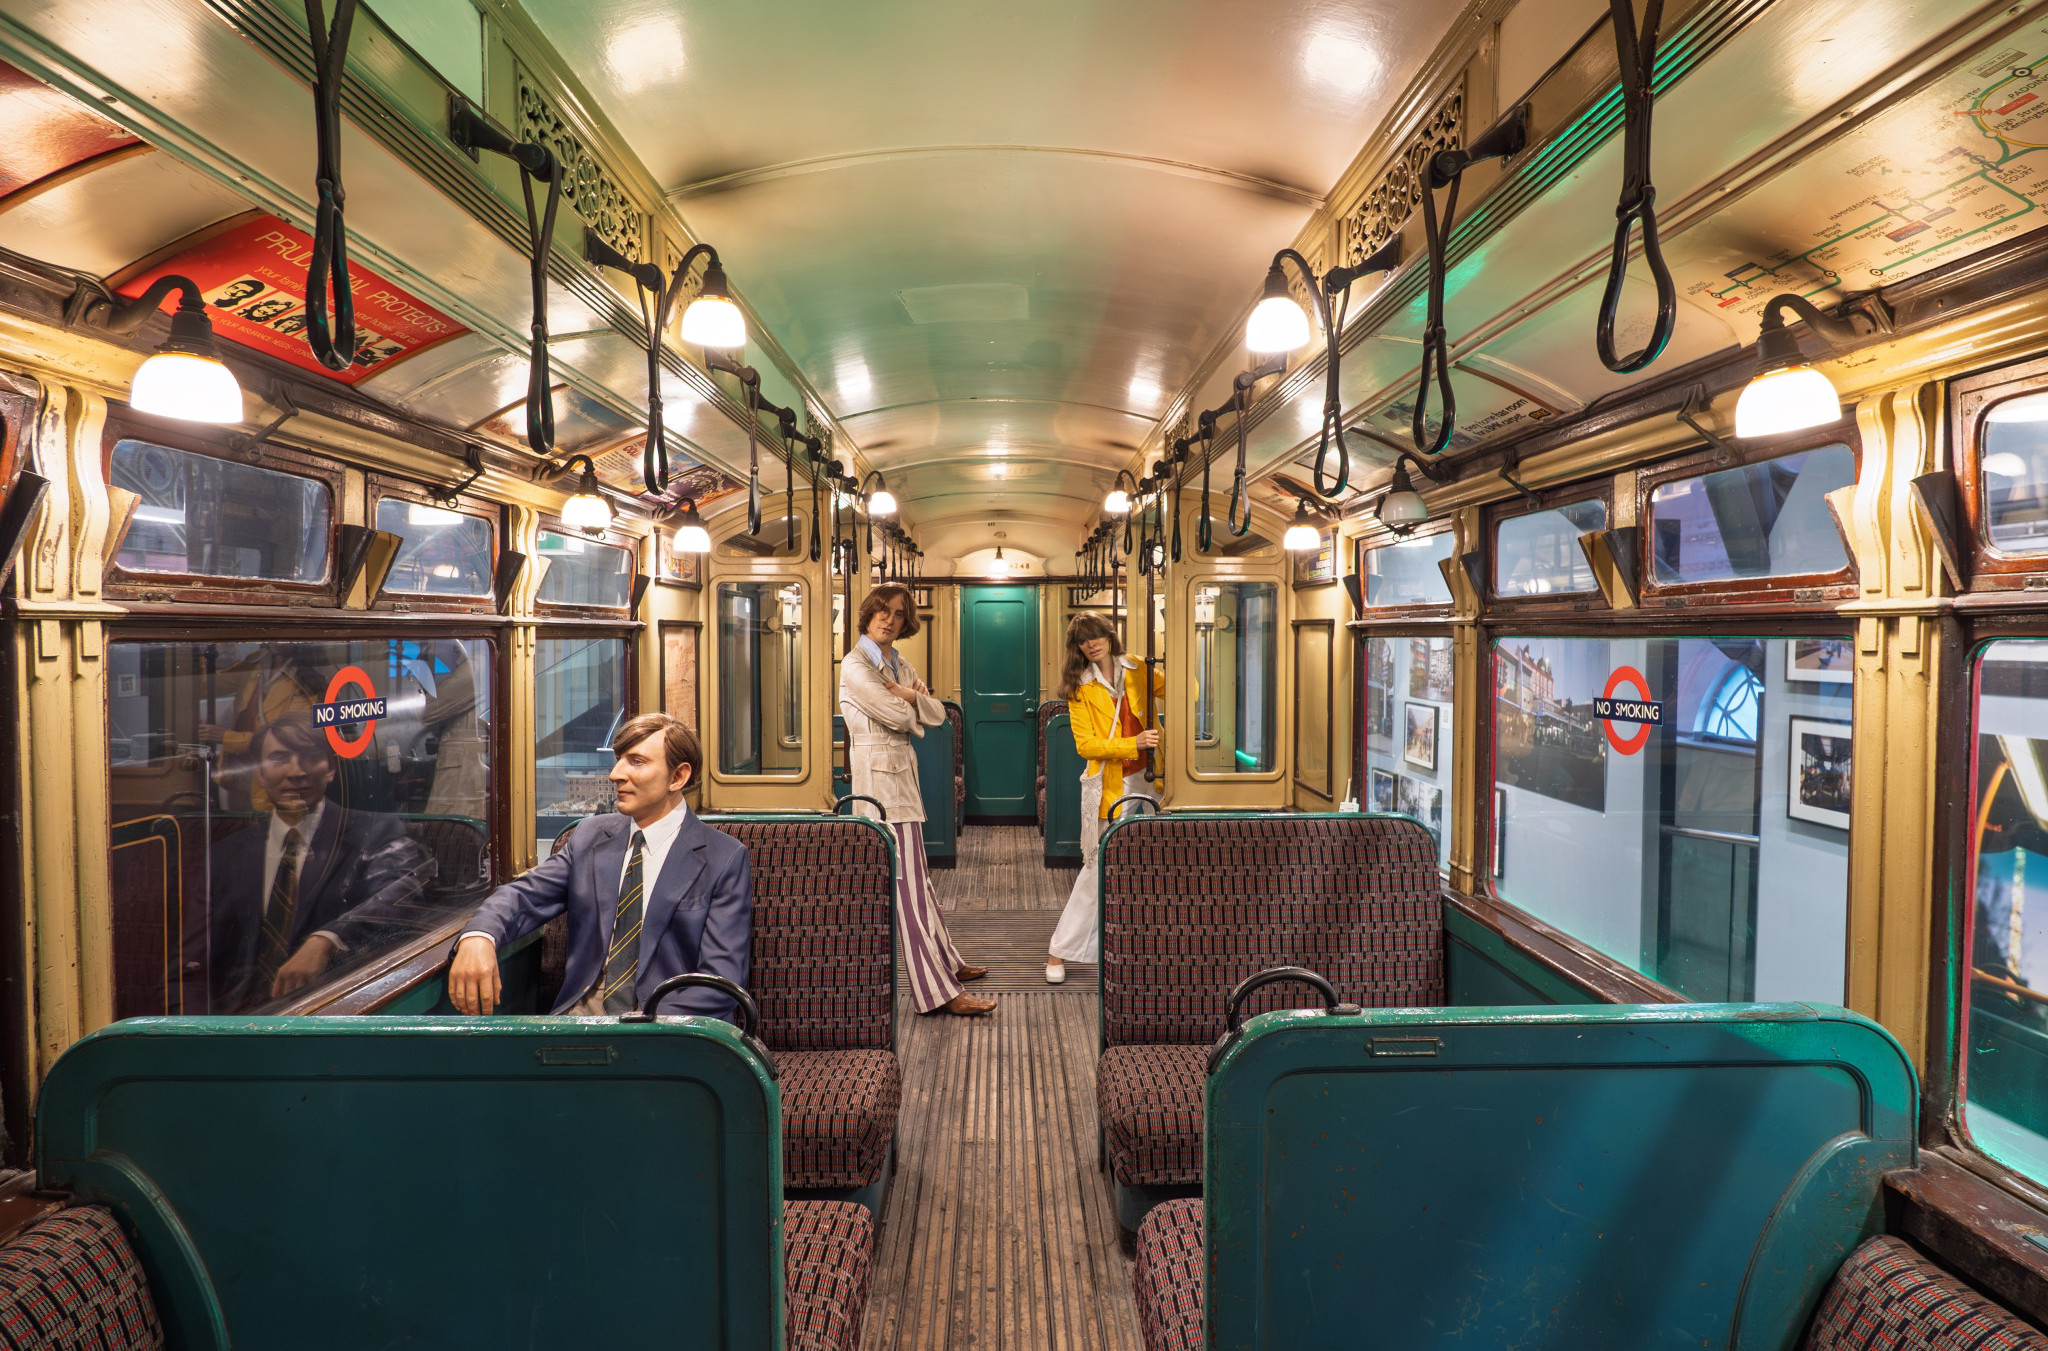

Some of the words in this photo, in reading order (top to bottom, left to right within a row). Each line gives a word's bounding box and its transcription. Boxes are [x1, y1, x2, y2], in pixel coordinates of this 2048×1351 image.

[2007, 73, 2048, 99] PADDING
[1993, 117, 2016, 130] High
[2016, 101, 2048, 117] Street
[2003, 106, 2048, 132] Kensingto
[2002, 167, 2036, 185] COURT
[1828, 195, 1879, 221] HAMMERSMITH
[1974, 203, 2006, 218] Parsons
[1984, 208, 2010, 220] Green
[1812, 222, 1842, 238] Stamford
[1992, 223, 2019, 236] Bridge
[254, 231, 370, 295] PRUDAL
[1505, 398, 1529, 412] room
[316, 706, 335, 723] NO
[340, 700, 384, 720] SMOKING
[1596, 700, 1611, 716] NO
[1615, 702, 1659, 720] SMOKING
